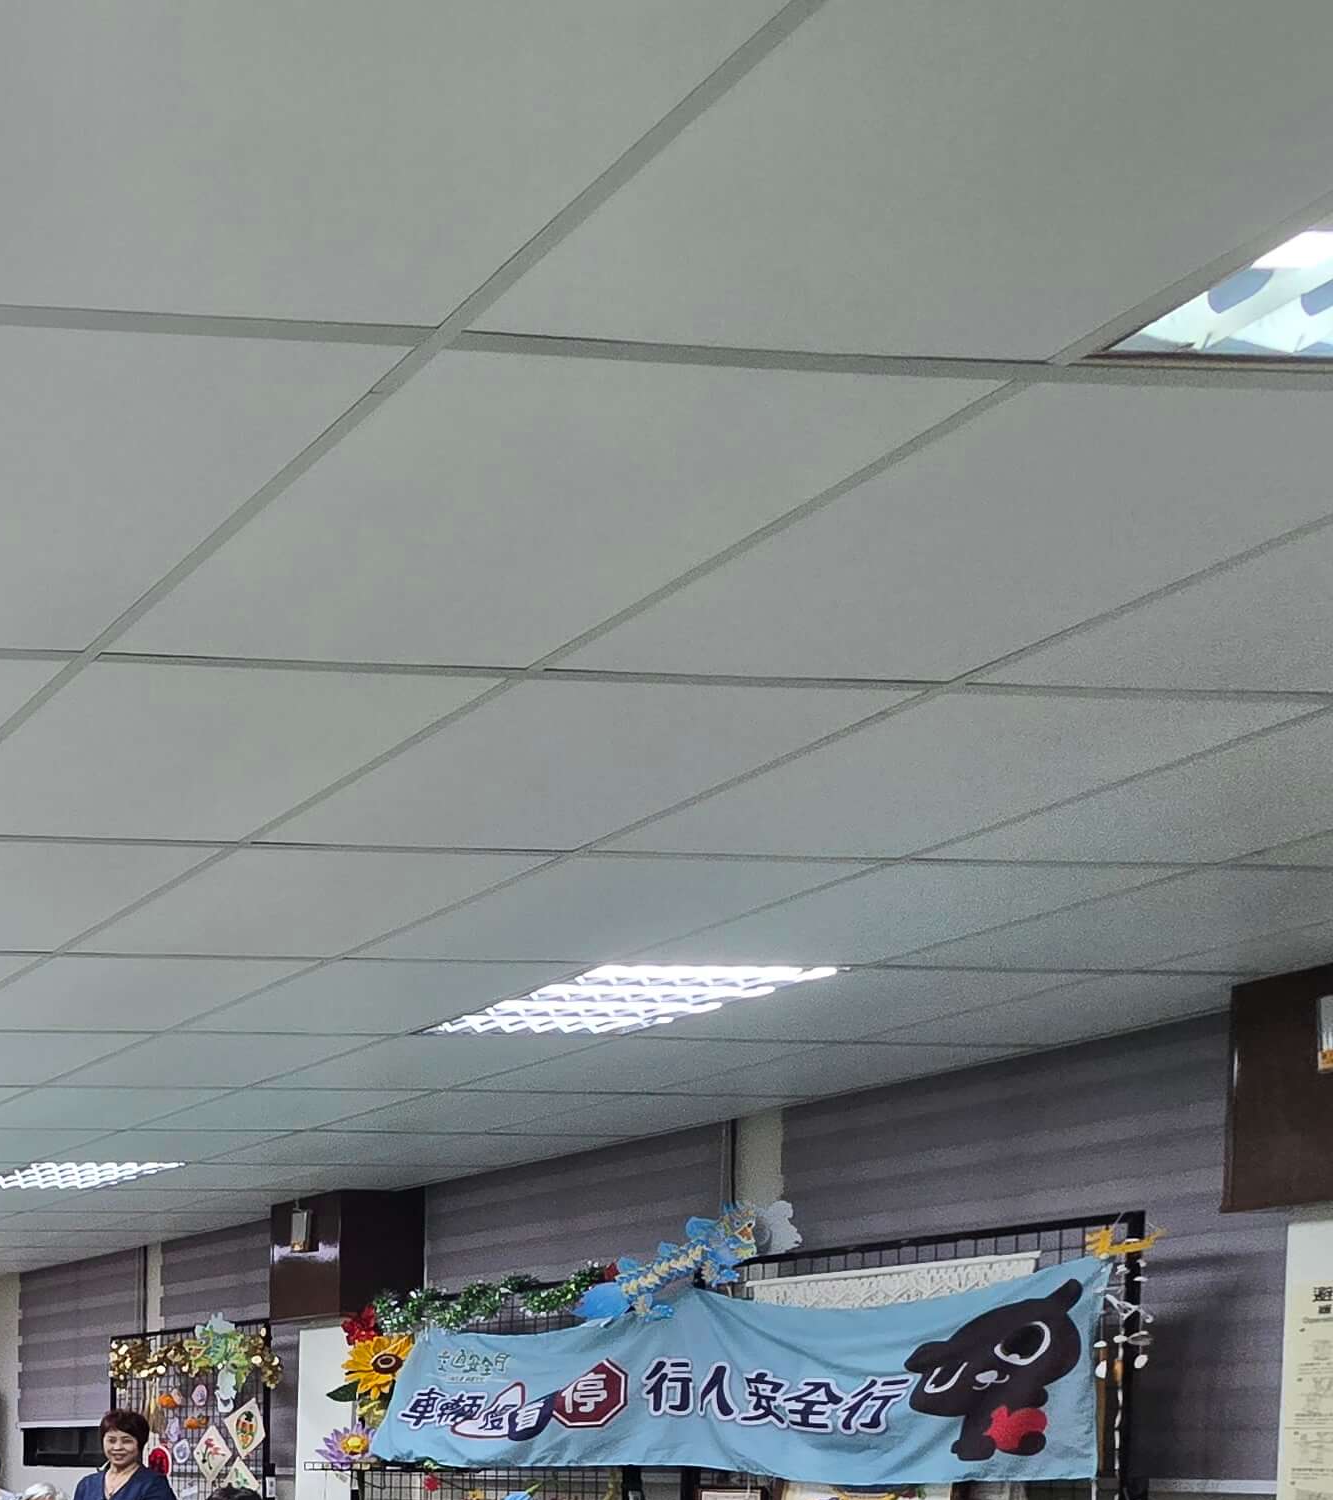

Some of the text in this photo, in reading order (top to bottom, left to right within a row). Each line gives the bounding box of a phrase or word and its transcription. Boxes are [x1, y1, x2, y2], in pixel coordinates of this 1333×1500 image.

[644, 1360, 910, 1430] 行人安全行
